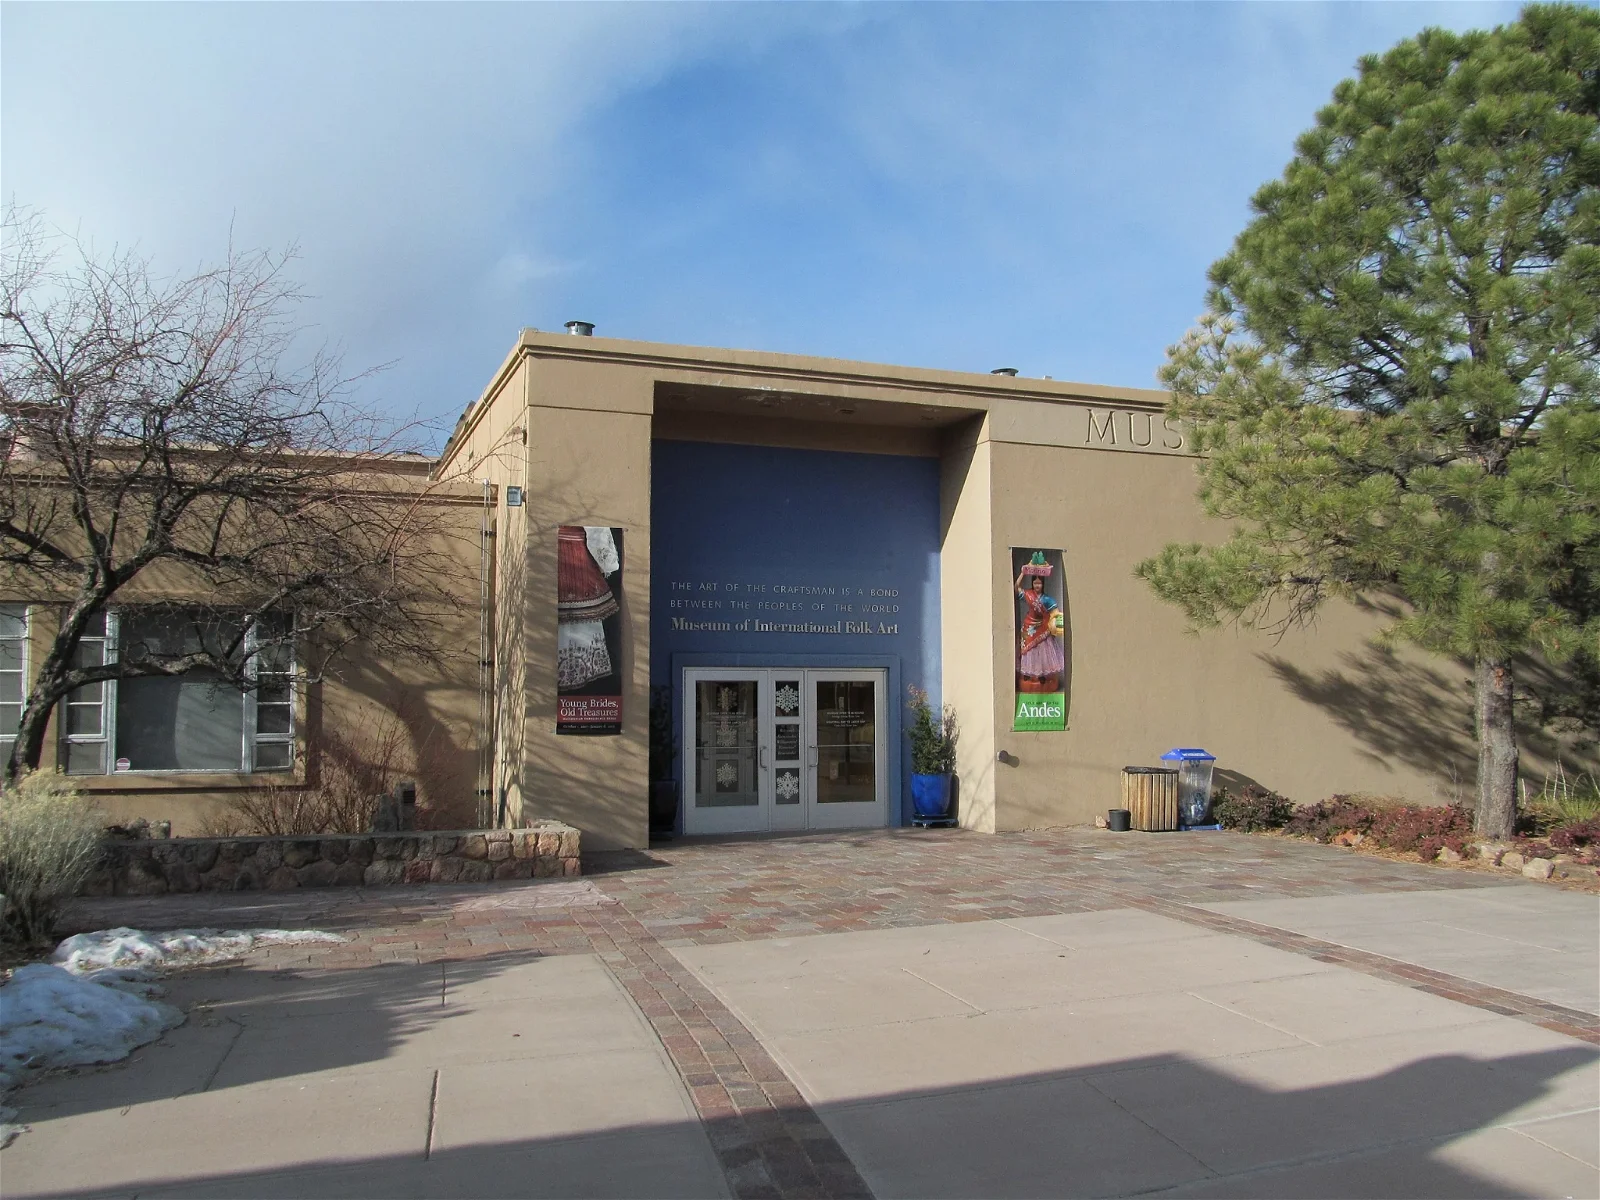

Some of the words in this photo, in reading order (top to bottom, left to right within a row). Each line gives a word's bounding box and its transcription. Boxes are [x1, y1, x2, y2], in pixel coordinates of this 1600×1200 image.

[1084, 408, 1211, 452] MUS
[671, 582, 691, 591] THE
[698, 582, 717, 592] ART
[725, 583, 738, 592] OF
[746, 584, 766, 593] THE
[773, 585, 835, 596] CRAFTSMAN
[842, 587, 850, 596] IS
[857, 588, 864, 596] A
[870, 588, 899, 598] BOND
[670, 599, 722, 609] BETWEEN
[730, 600, 750, 610] THE
[758, 601, 803, 611] PEOPLES
[811, 602, 825, 611] OF
[834, 603, 853, 612] THE
[861, 604, 900, 613] WORLD
[671, 617, 731, 631] Museum
[735, 619, 751, 632] of
[754, 619, 841, 634] International
[845, 621, 873, 634] Folk
[877, 621, 899, 634] Art
[560, 699, 588, 709] Young
[590, 699, 618, 708] Brides,
[1018, 702, 1061, 718] Andes
[560, 708, 576, 717] Old
[578, 708, 619, 717] Treasures
